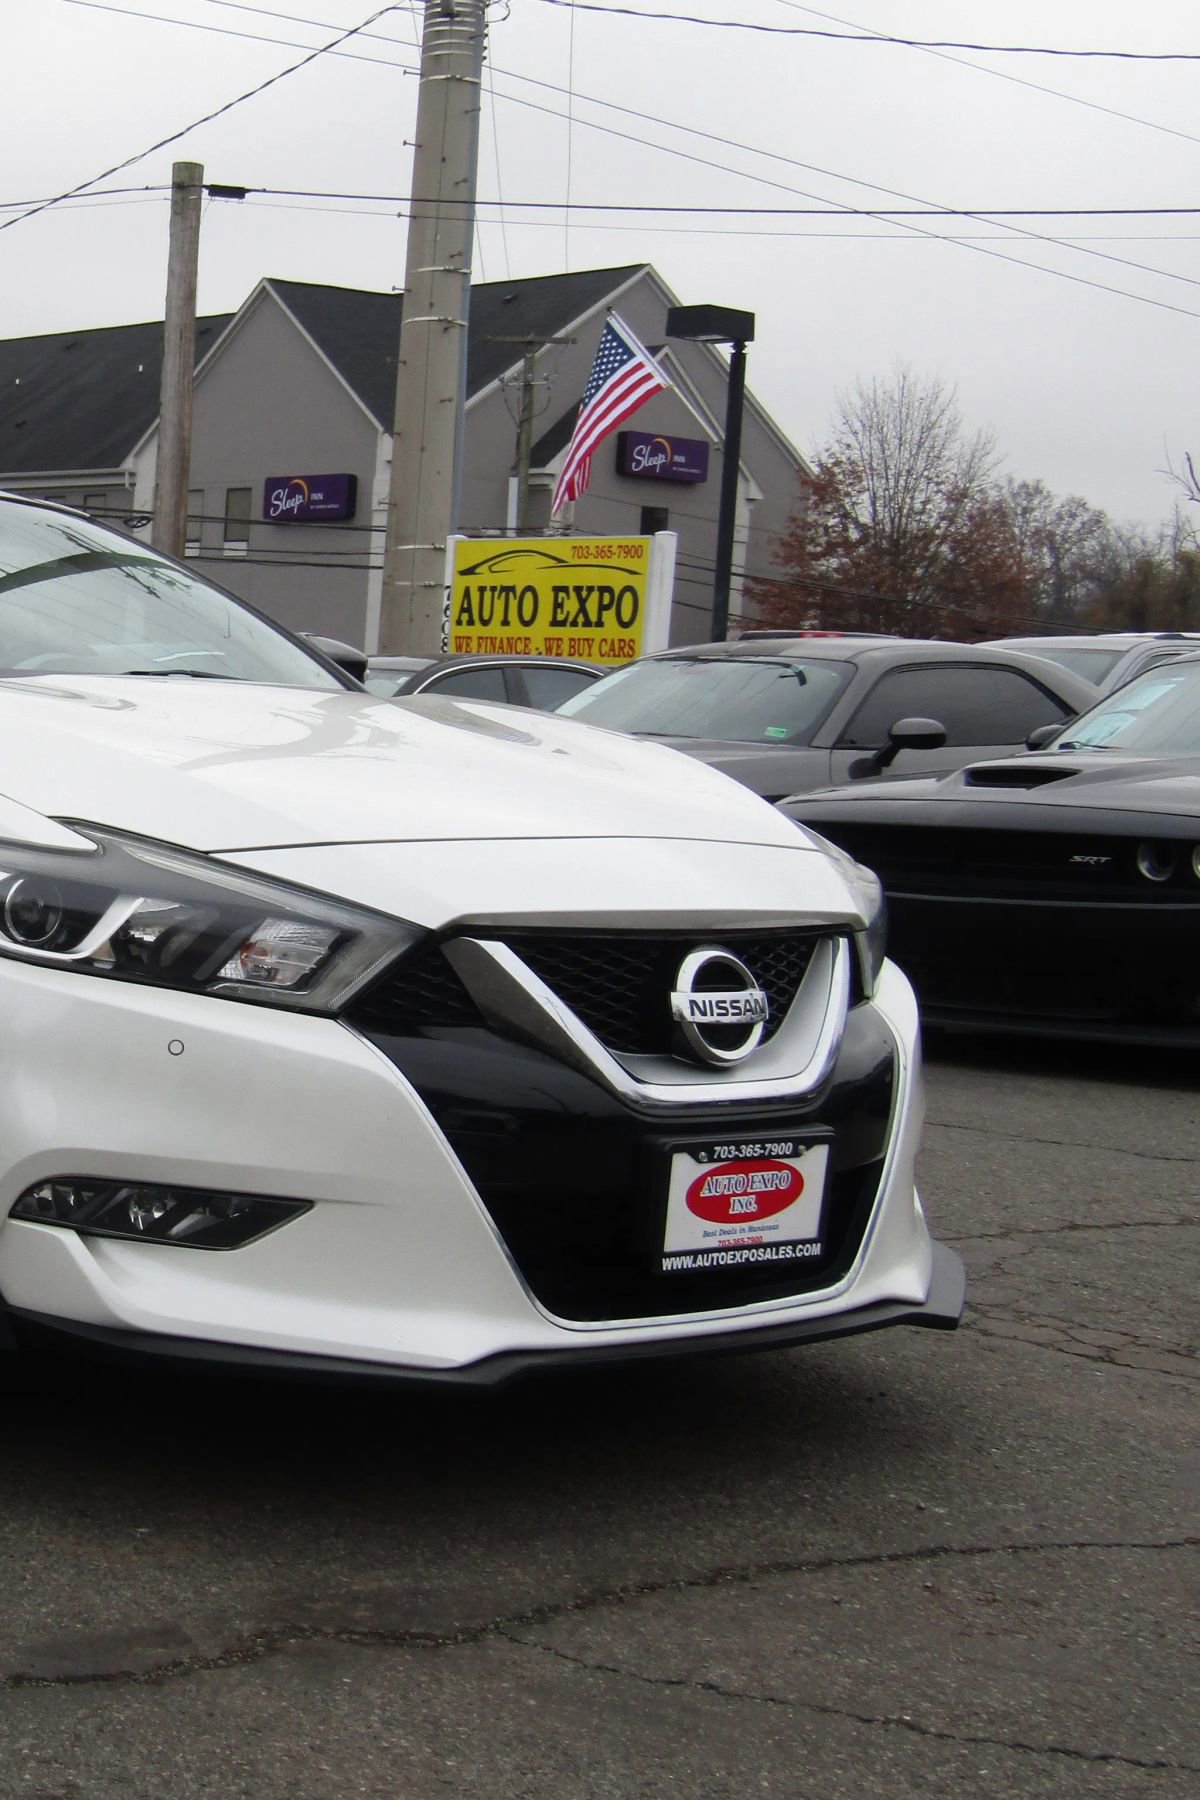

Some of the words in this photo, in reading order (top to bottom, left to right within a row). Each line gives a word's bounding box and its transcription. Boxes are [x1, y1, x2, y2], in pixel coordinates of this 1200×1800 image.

[631, 445, 666, 473] Sleep
[270, 488, 304, 516] Sleep
[571, 545, 643, 559] 703-365-7900
[456, 584, 539, 628] AUTO
[549, 584, 640, 630] EXPO
[454, 635, 473, 654] WE
[477, 636, 532, 656] FINANCE
[544, 637, 563, 656] WE
[568, 638, 596, 657] BUY
[599, 638, 636, 658] CARS
[1068, 855, 1112, 865] SRT
[688, 998, 766, 1017] NISSAN
[713, 1142, 793, 1159] 703-365-7900
[700, 1173, 746, 1197] AUTO
[747, 1170, 792, 1193] EXPO
[729, 1195, 757, 1214] INC.
[662, 1243, 821, 1271] WWW.AUTOEXPOSALES.COM
